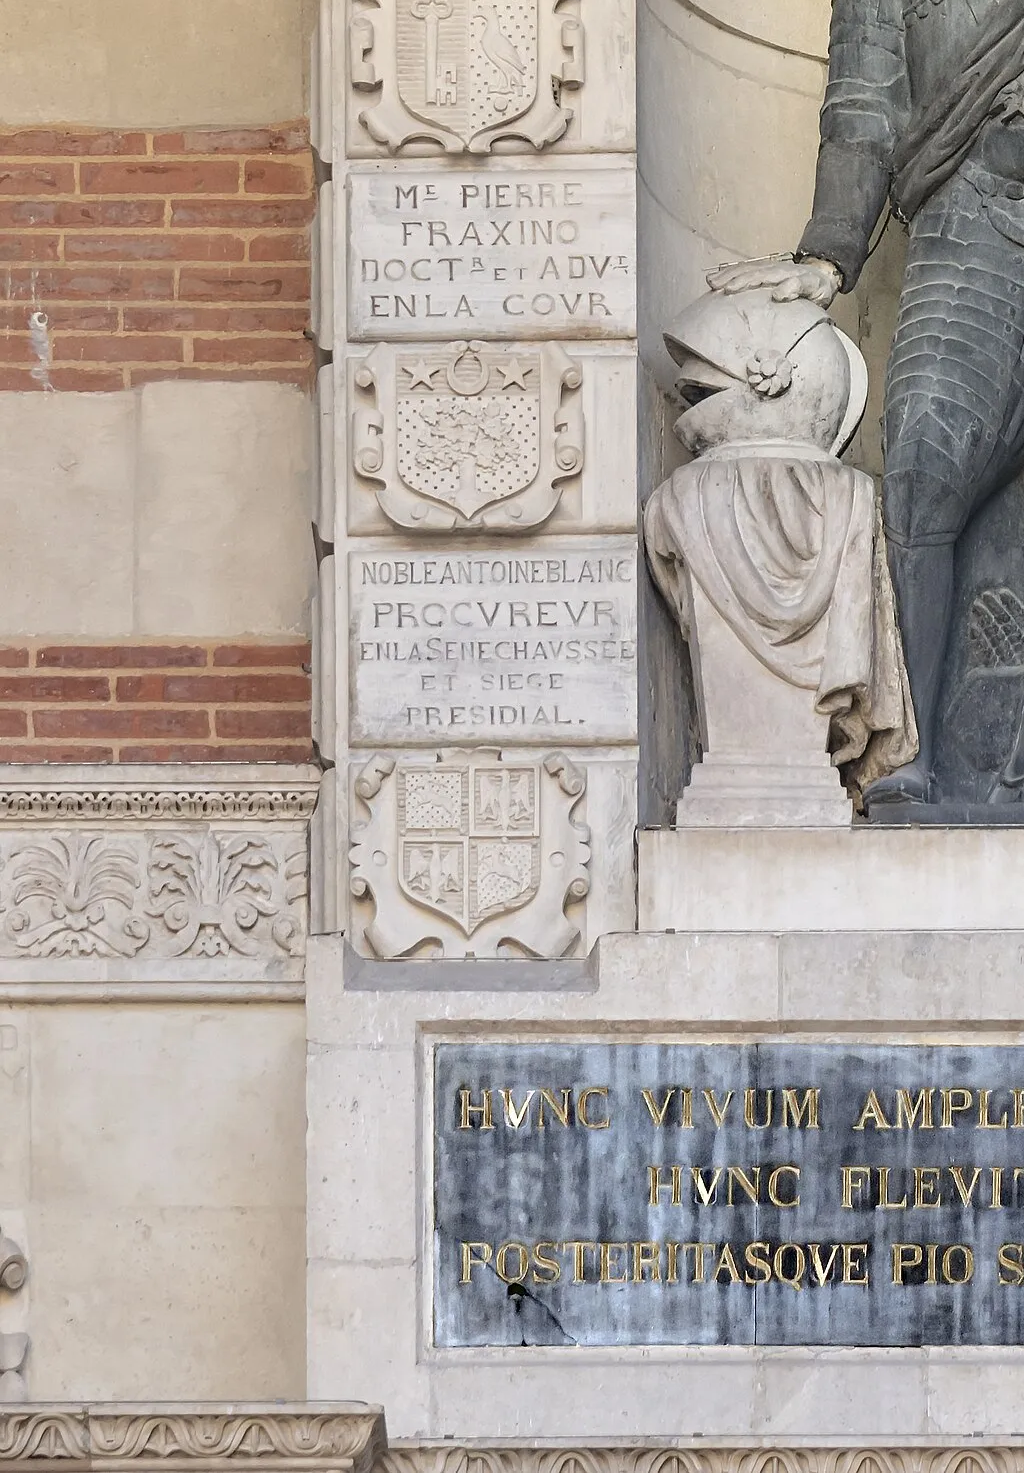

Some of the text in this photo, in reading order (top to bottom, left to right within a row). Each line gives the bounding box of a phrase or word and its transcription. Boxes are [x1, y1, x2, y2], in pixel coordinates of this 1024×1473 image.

[460, 183, 583, 209] PIERRE
[402, 220, 579, 246] FRAXINO
[502, 292, 612, 317] COVR
[459, 1087, 609, 1129] HVNC
[641, 1087, 821, 1129] VIVUM
[647, 1165, 801, 1208] HVNC
[459, 1241, 869, 1290] POSTERITASQVE
[891, 1242, 974, 1284] PIO
